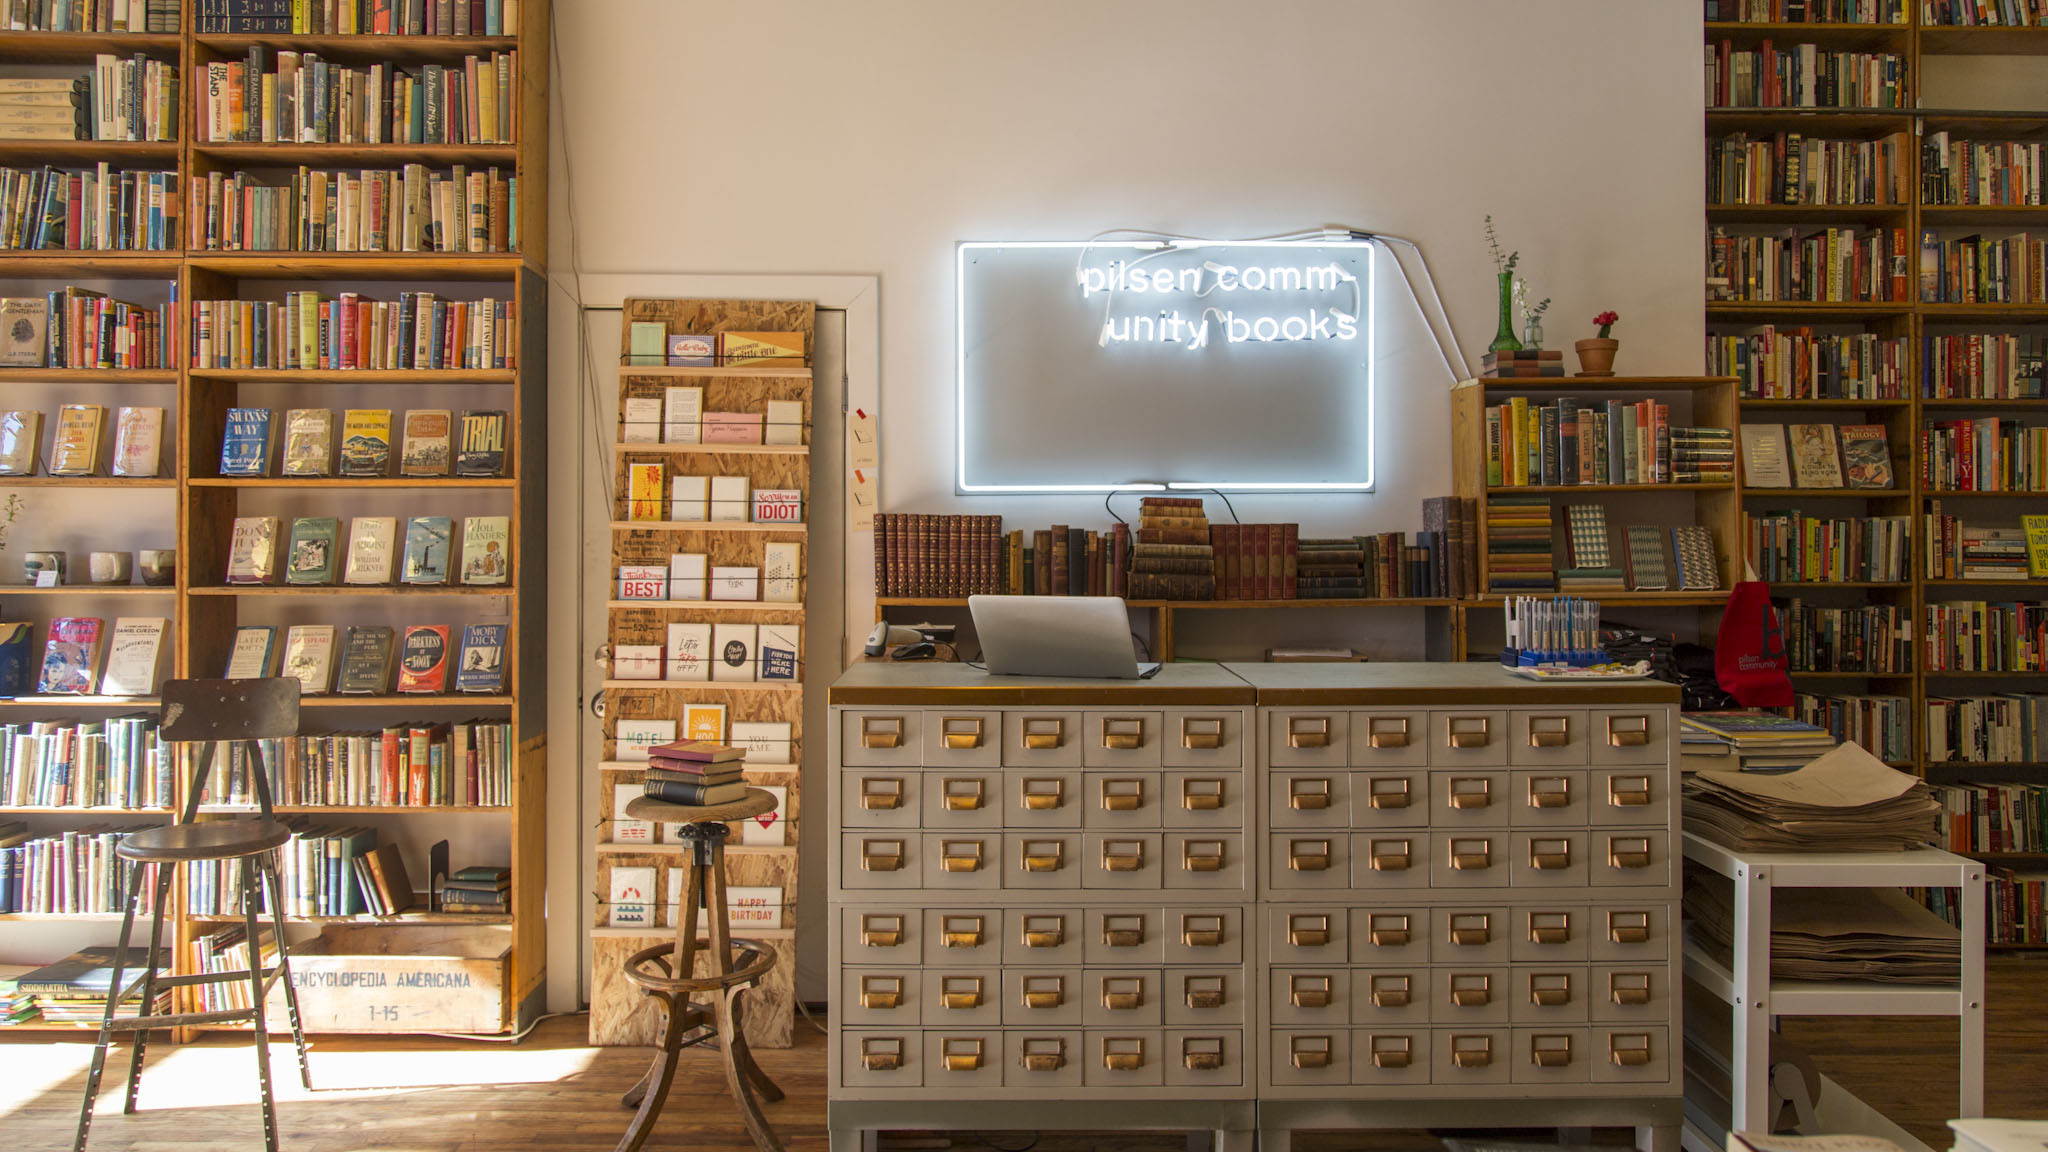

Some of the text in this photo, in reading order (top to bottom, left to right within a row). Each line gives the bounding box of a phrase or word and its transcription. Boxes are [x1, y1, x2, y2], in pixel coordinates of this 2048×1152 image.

[220, 67, 228, 82] THE
[210, 66, 220, 96] STAND
[250, 68, 259, 107] CERAMICS
[1083, 260, 1200, 298] pilsen
[1107, 308, 1357, 350] unity books
[234, 424, 258, 435] WAY
[462, 416, 504, 452] TRIAL
[1490, 422, 1499, 462] GRAHAM GREENE
[1845, 432, 1880, 441] TRILOGY
[759, 504, 798, 520] IDIOT
[236, 528, 262, 537] DON
[466, 532, 506, 540] FLANDERS
[624, 582, 663, 597] BEST
[470, 626, 498, 636] MOBY
[634, 624, 648, 632] 520
[1762, 604, 1786, 660] b
[407, 636, 440, 648] DARKNESS
[470, 636, 498, 645] DICK
[411, 655, 430, 668] NOON
[770, 659, 791, 667] WERE
[1738, 653, 1760, 664] pilsen
[770, 666, 791, 676] HERE
[1739, 662, 1776, 670] community
[626, 731, 665, 745] MOTEL
[749, 736, 768, 744] YOU
[738, 898, 766, 906] HAPPY
[730, 910, 773, 920] BIRTHDAY
[292, 972, 470, 988] ENCYCLOPEDIA AMERICANA
[20, 983, 68, 992] SIDDHARTHA
[369, 1005, 398, 1021] 1-15
